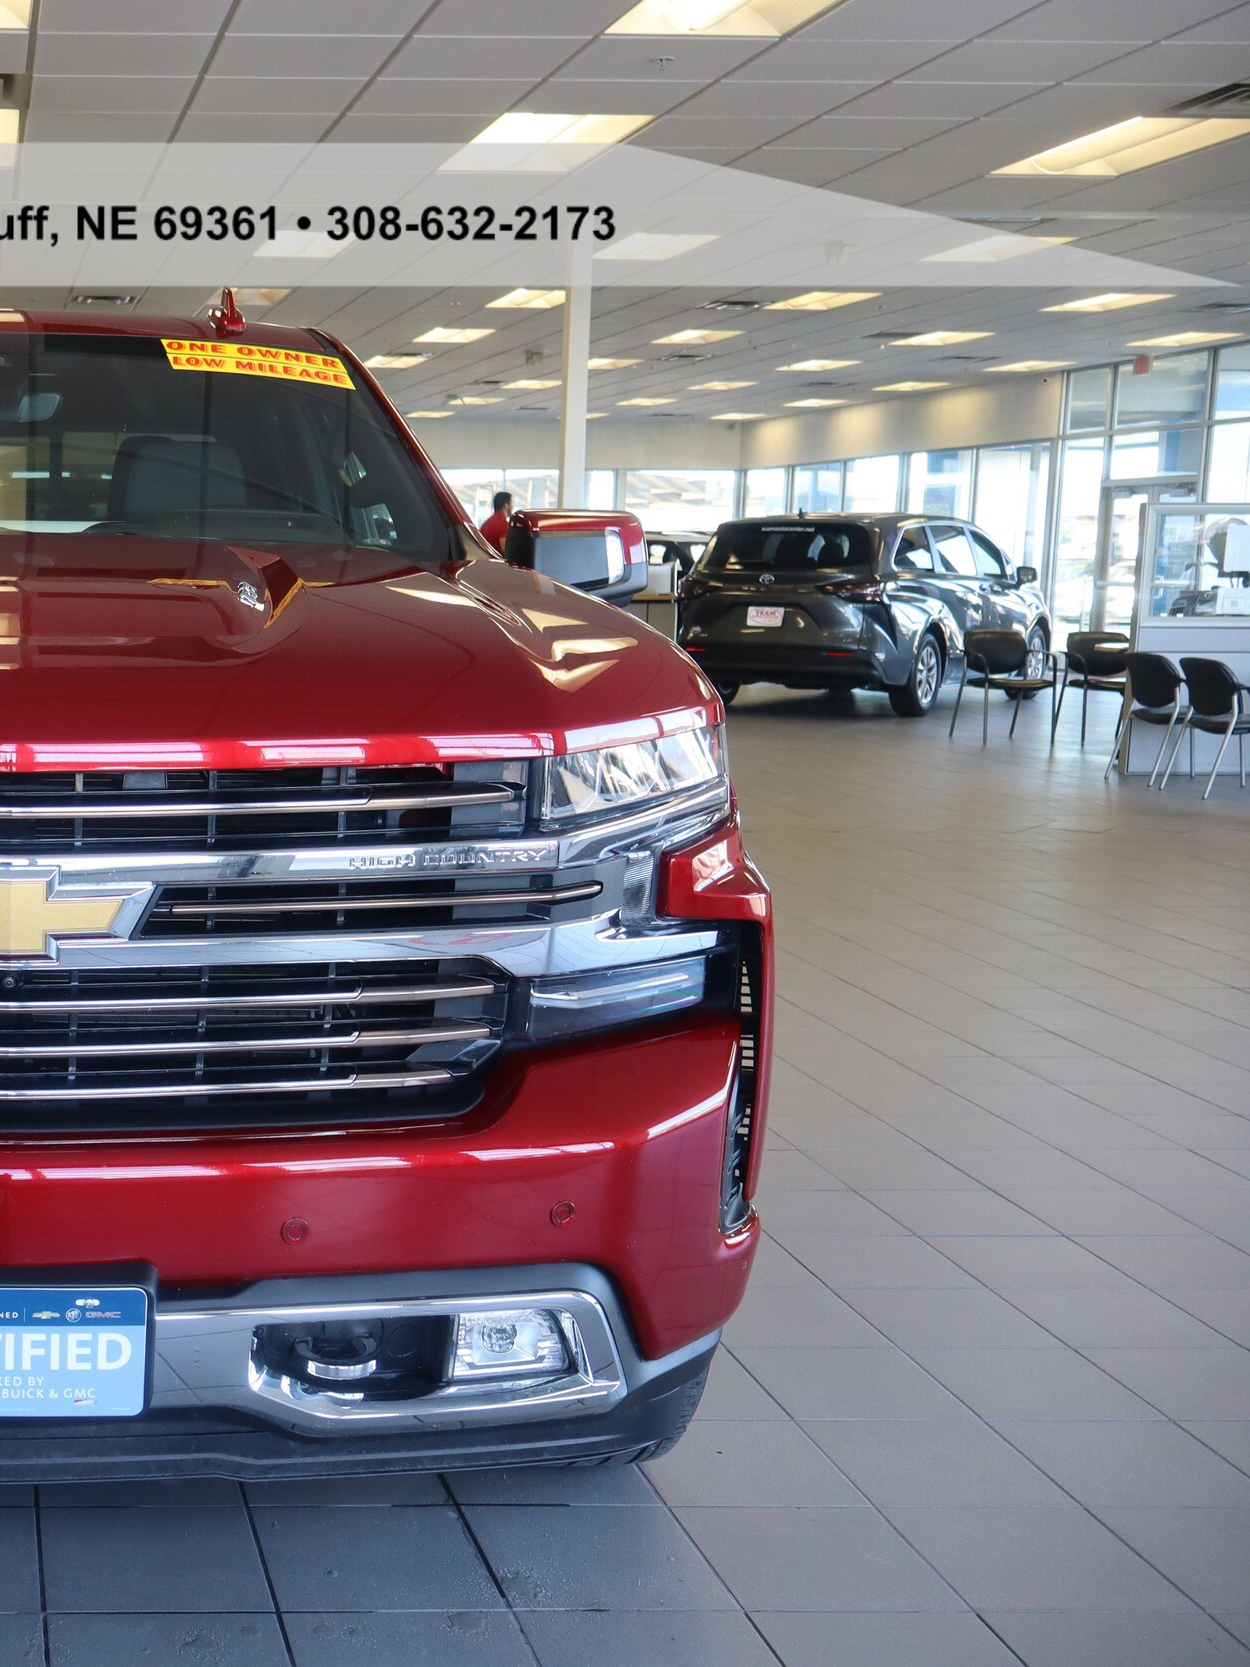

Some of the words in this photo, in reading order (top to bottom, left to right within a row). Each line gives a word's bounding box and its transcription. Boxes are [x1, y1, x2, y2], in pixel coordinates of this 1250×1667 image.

[166, 341, 227, 354] ONE
[236, 346, 340, 369] OWNER
[172, 356, 225, 368] LOW
[235, 360, 348, 385] MILEAGE
[348, 854, 417, 870] HIGH
[423, 849, 547, 867] COUNTRY
[85, 1311, 122, 1319] GMC
[27, 1376, 45, 1387] BY
[1, 1387, 44, 1399] BUICK
[48, 1388, 59, 1399] &
[63, 1388, 96, 1399] GMC
